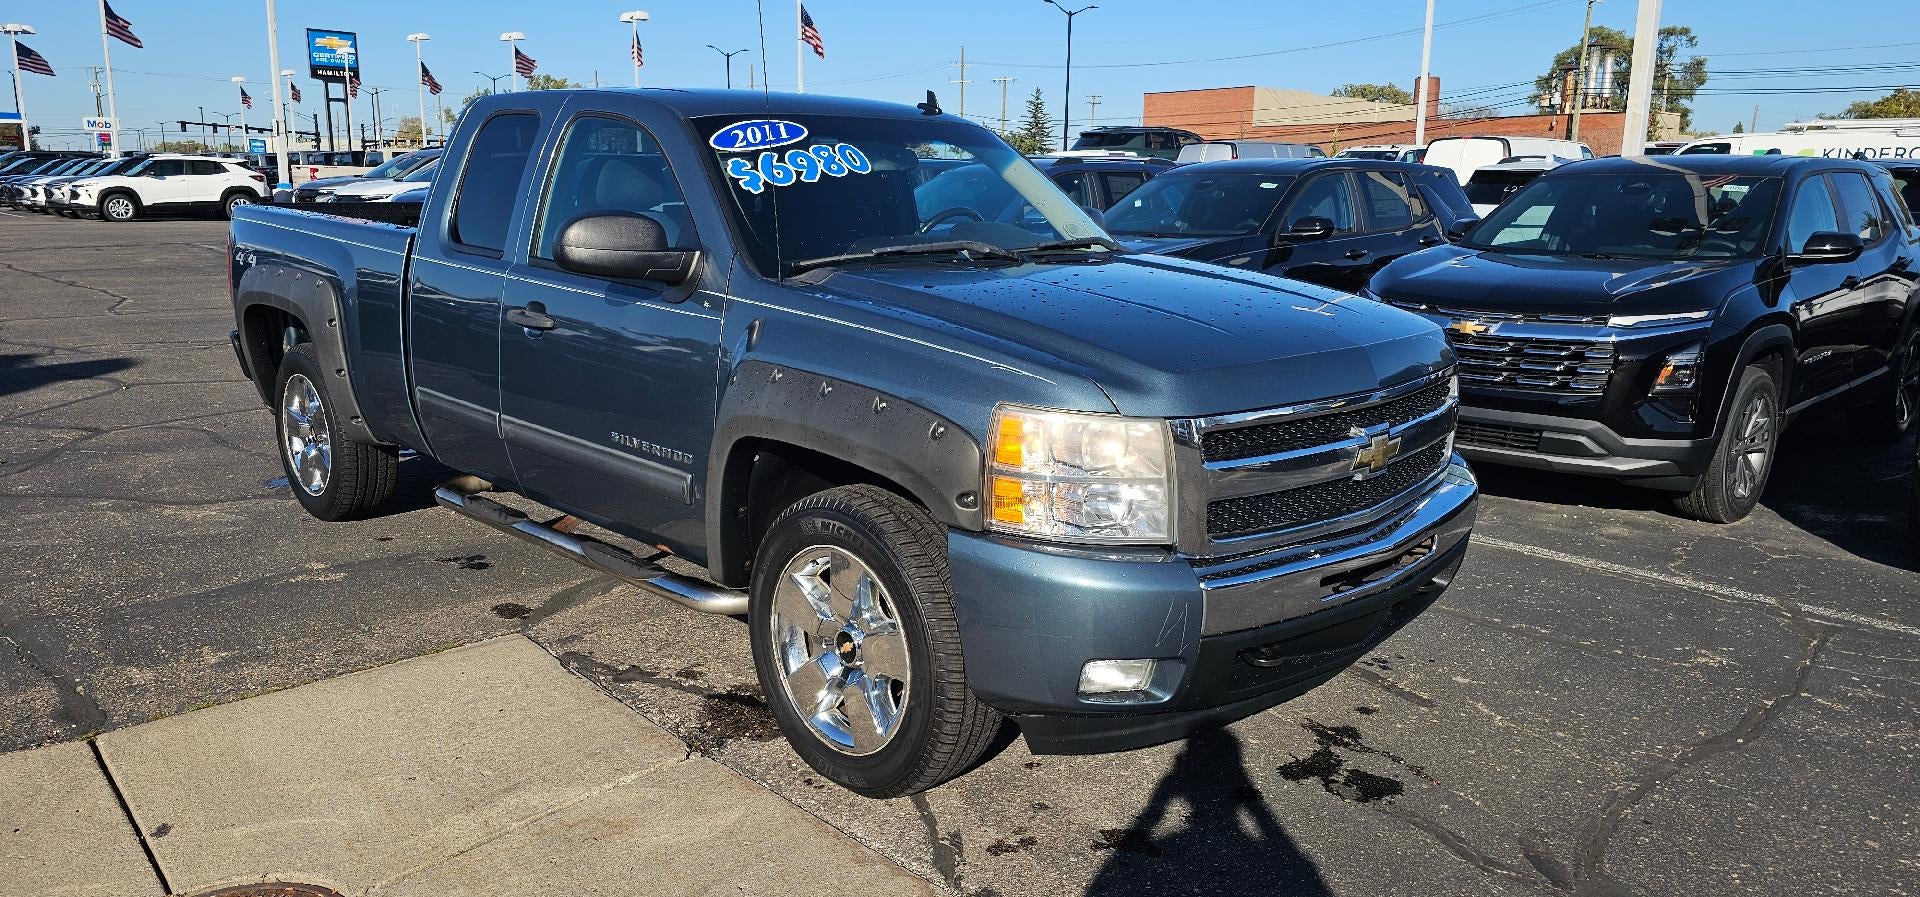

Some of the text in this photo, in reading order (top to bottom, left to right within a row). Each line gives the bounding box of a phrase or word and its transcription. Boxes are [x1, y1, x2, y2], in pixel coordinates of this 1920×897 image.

[87, 119, 112, 129] Mob
[730, 122, 791, 148] 2011
[727, 143, 872, 195] $6980
